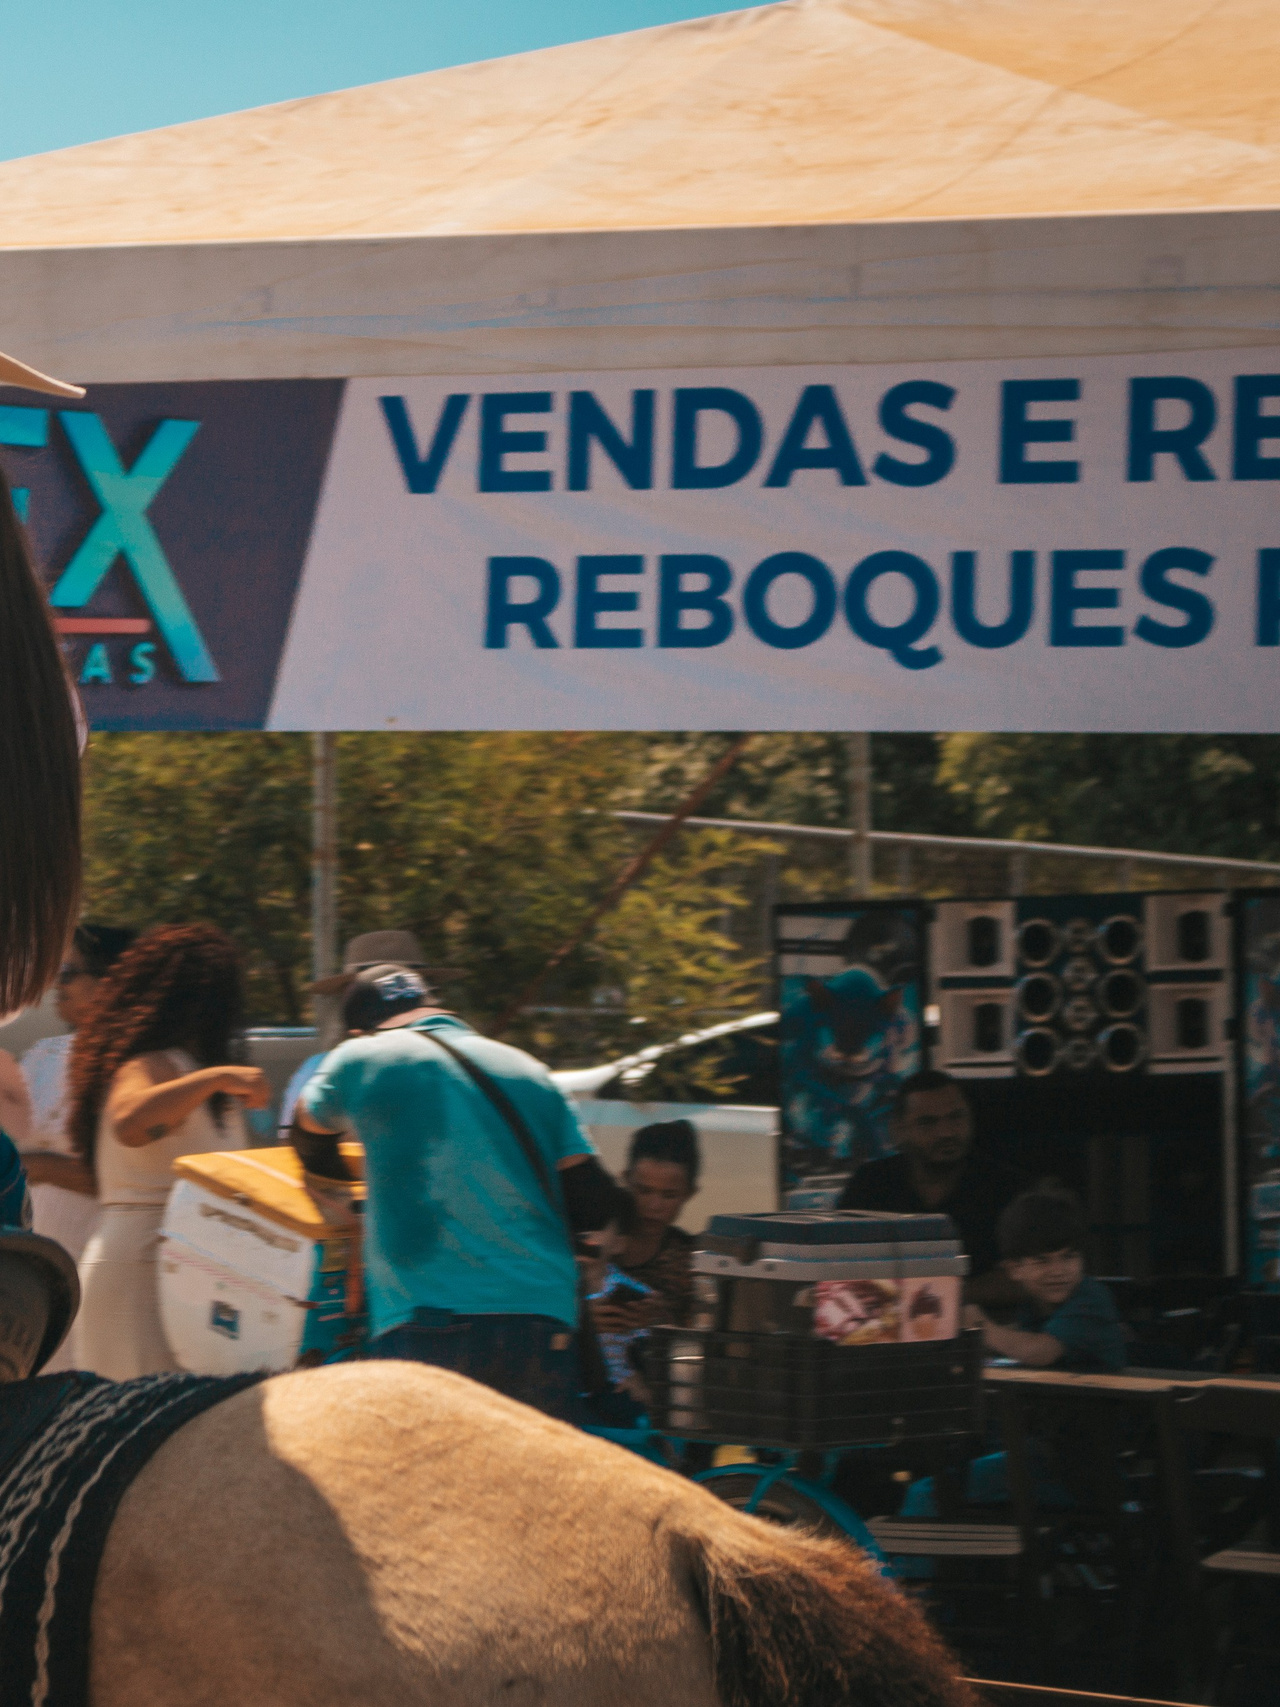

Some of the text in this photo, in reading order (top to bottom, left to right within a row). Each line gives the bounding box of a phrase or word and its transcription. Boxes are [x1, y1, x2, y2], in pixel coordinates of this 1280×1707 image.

[378, 373, 1280, 494] VENDAS E RE
[61, 641, 157, 685] AS
[483, 547, 1217, 670] REBOQUES
